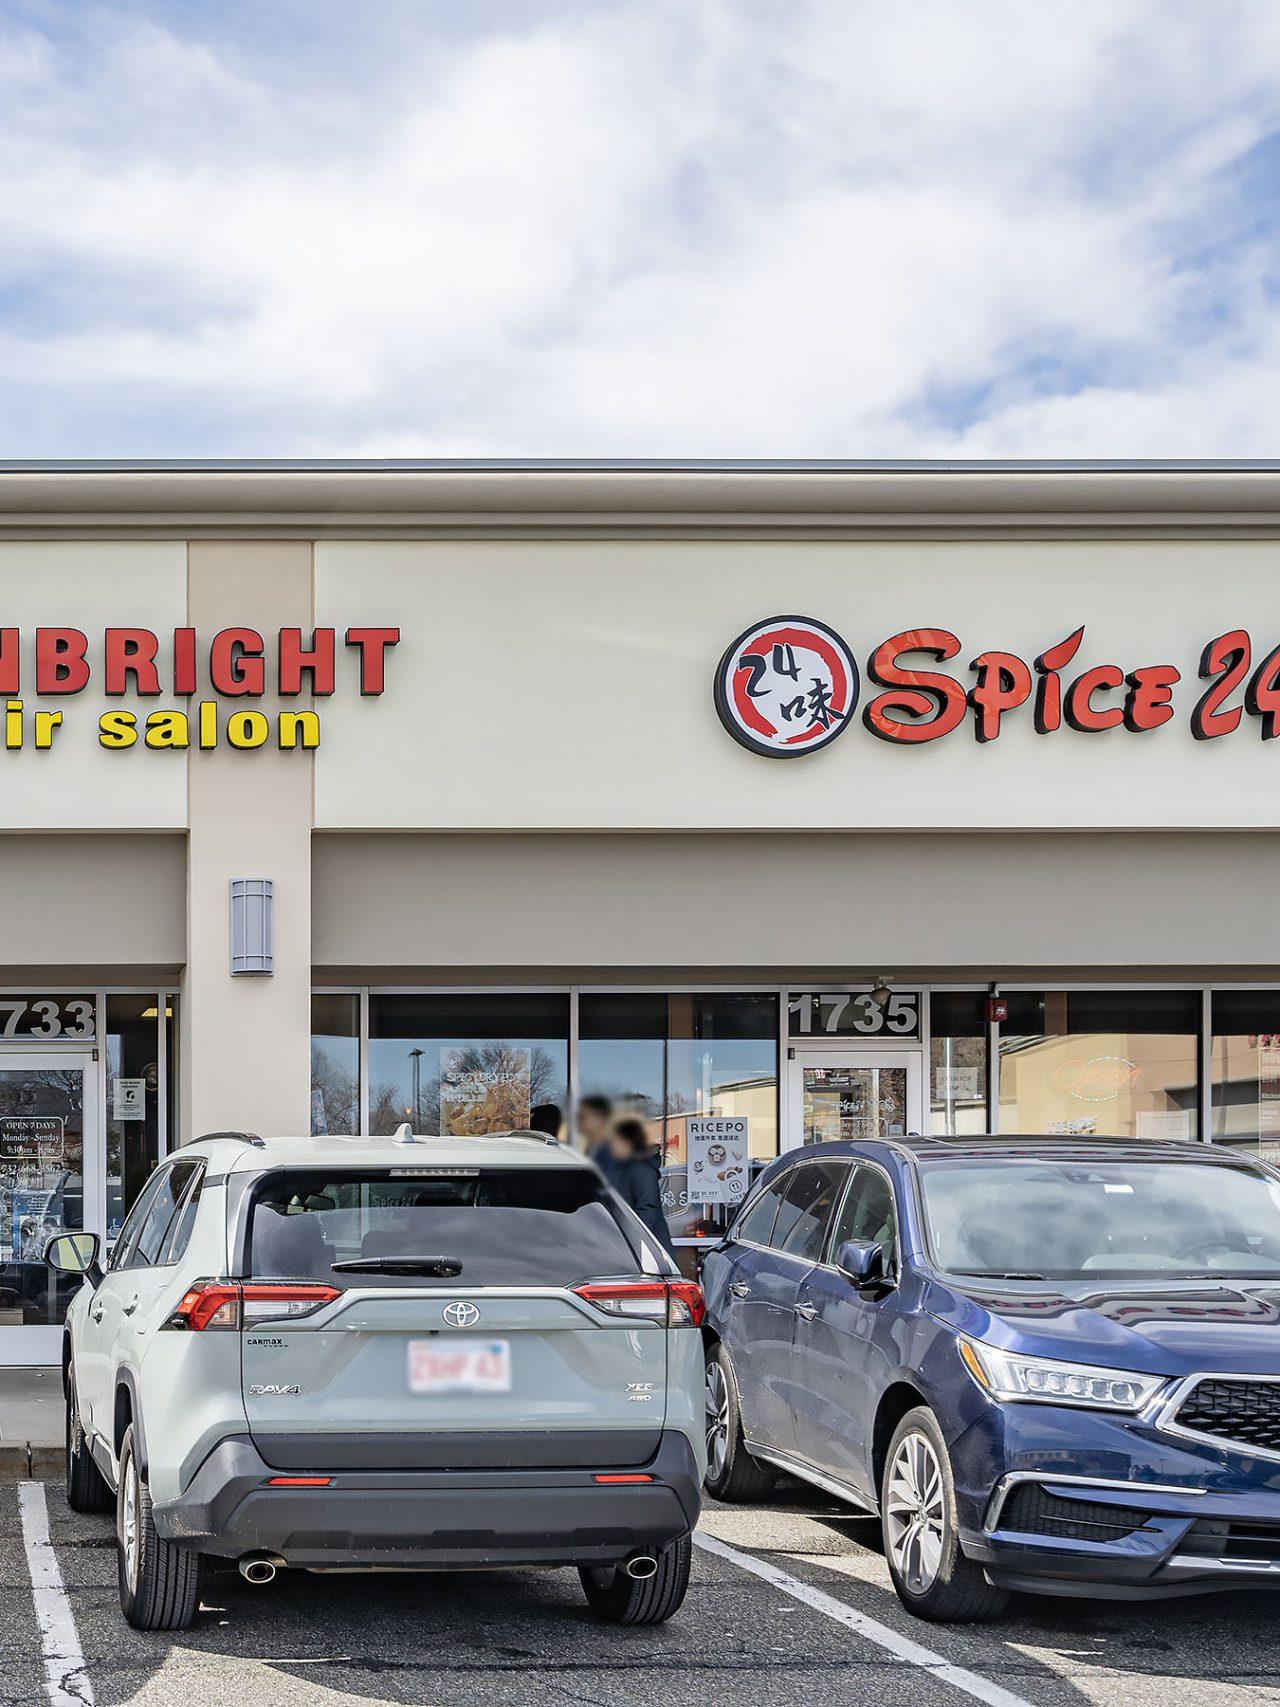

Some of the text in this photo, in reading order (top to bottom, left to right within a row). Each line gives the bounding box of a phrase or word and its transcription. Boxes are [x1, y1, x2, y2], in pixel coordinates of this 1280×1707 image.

[739, 644, 801, 698] 24
[1190, 629, 1280, 741] 24
[780, 678, 846, 730] 味
[98, 701, 320, 750] salon
[789, 994, 917, 1033] 1735
[2, 1133, 29, 1142] Monday
[33, 1133, 59, 1142] Sunday
[6, 1121, 29, 1129] OPEN
[36, 1121, 56, 1129] DAYS
[690, 1122, 745, 1133] RICEPO
[248, 1384, 301, 1396] RAV4
